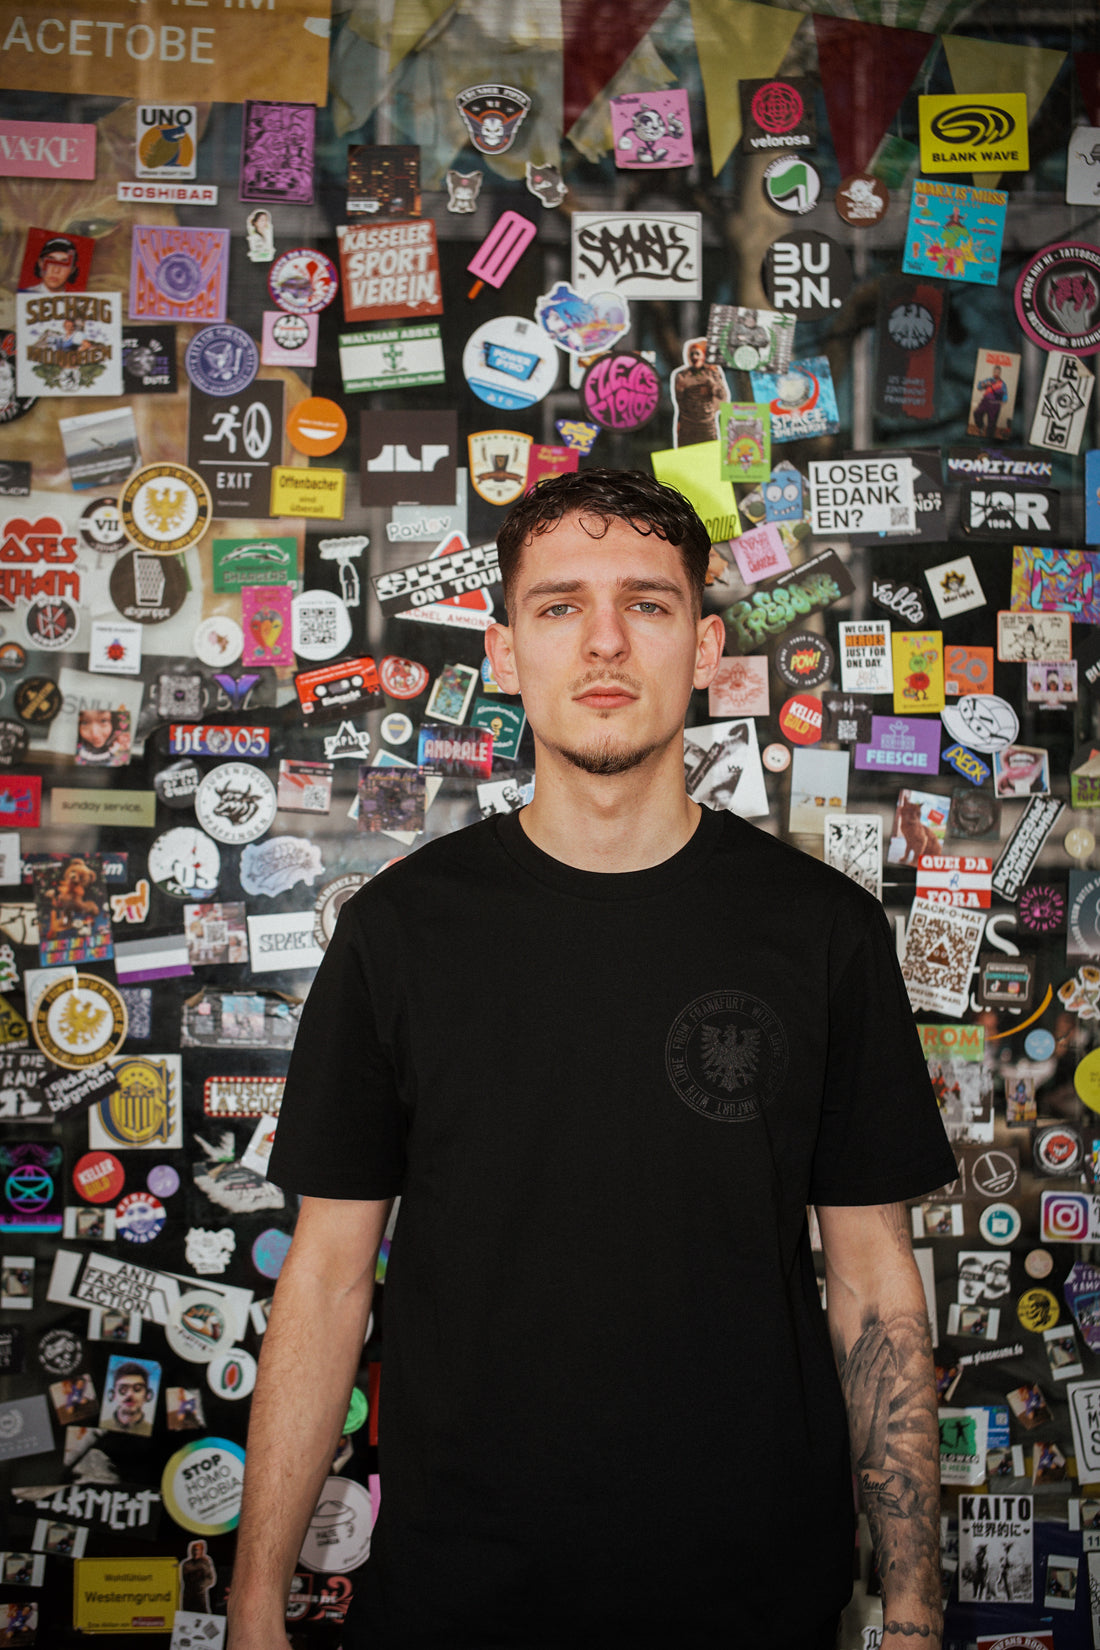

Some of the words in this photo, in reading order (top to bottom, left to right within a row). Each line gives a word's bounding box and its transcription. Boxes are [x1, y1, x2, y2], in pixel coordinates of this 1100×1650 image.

[2, 15, 216, 64] ACETOBE
[140, 108, 193, 126] UNO
[750, 134, 811, 149] velorosa
[931, 152, 978, 163] BLANK
[981, 150, 1020, 162] WAVE
[120, 186, 214, 201] TOSHIBAR
[914, 180, 951, 199] MARX
[972, 186, 1008, 207] MUSS
[342, 222, 431, 250] KASSELER
[347, 247, 433, 279] SPORT
[773, 242, 831, 275] BU
[773, 276, 842, 308] RN.
[25, 296, 113, 325] SECHZIG
[340, 328, 399, 346] WALTHAM
[400, 326, 440, 340] ABBEY
[493, 347, 533, 368] POWER
[495, 357, 526, 374] PYRO
[771, 408, 828, 430] SPACE
[215, 471, 253, 490] EXIT
[279, 474, 339, 492] Offenbacher
[813, 463, 899, 485] LOSEG
[815, 484, 901, 507] EDANK
[817, 509, 864, 529] EN?
[0, 535, 79, 564] OSES
[409, 586, 446, 607] ON
[844, 625, 856, 634] WE
[857, 625, 874, 634] CAN
[875, 624, 886, 633] BE
[844, 634, 886, 647] HEROES
[845, 647, 865, 657] JUST
[868, 647, 886, 657] FOR
[846, 658, 863, 668] ONE
[233, 728, 267, 754] 05
[62, 800, 100, 814] sunday
[103, 801, 144, 813] service.
[920, 855, 961, 870] QUEI
[964, 857, 989, 871] DA
[926, 890, 981, 908] FORA
[689, 996, 746, 1023] FRANKFURT
[750, 1005, 775, 1030] WITH
[672, 1022, 691, 1051] FROM
[19, 1053, 47, 1068] DIE
[671, 1055, 689, 1085] LOVE
[217, 1098, 233, 1112] A
[684, 1084, 711, 1109] WITH
[77, 1158, 116, 1185] KELLER
[84, 1268, 155, 1299] FASCIST
[116, 1263, 157, 1285] ANTI
[82, 1286, 147, 1316] ACTION
[180, 1453, 223, 1481] STOP
[184, 1464, 232, 1496] HOMO
[187, 1476, 243, 1511] PHOBIA
[961, 1496, 1032, 1521] KAITO
[971, 1521, 1022, 1538] 世界的に
[83, 1590, 172, 1605] Westerngrund
